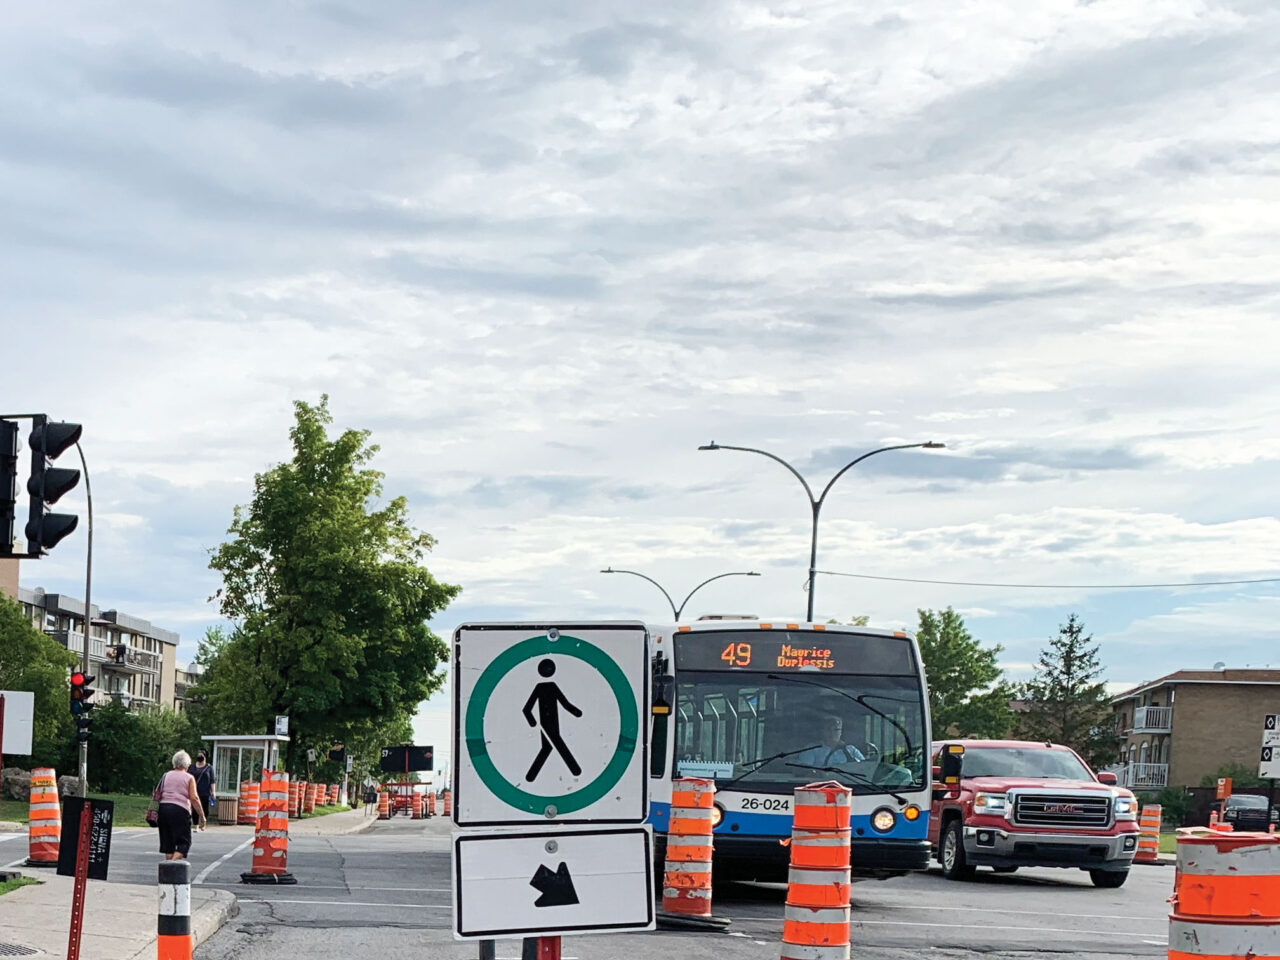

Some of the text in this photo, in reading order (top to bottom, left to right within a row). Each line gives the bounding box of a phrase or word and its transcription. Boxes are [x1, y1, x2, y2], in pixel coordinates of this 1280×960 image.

[721, 642, 832, 667] 49 Maurice
[741, 797, 789, 811] 26-024
